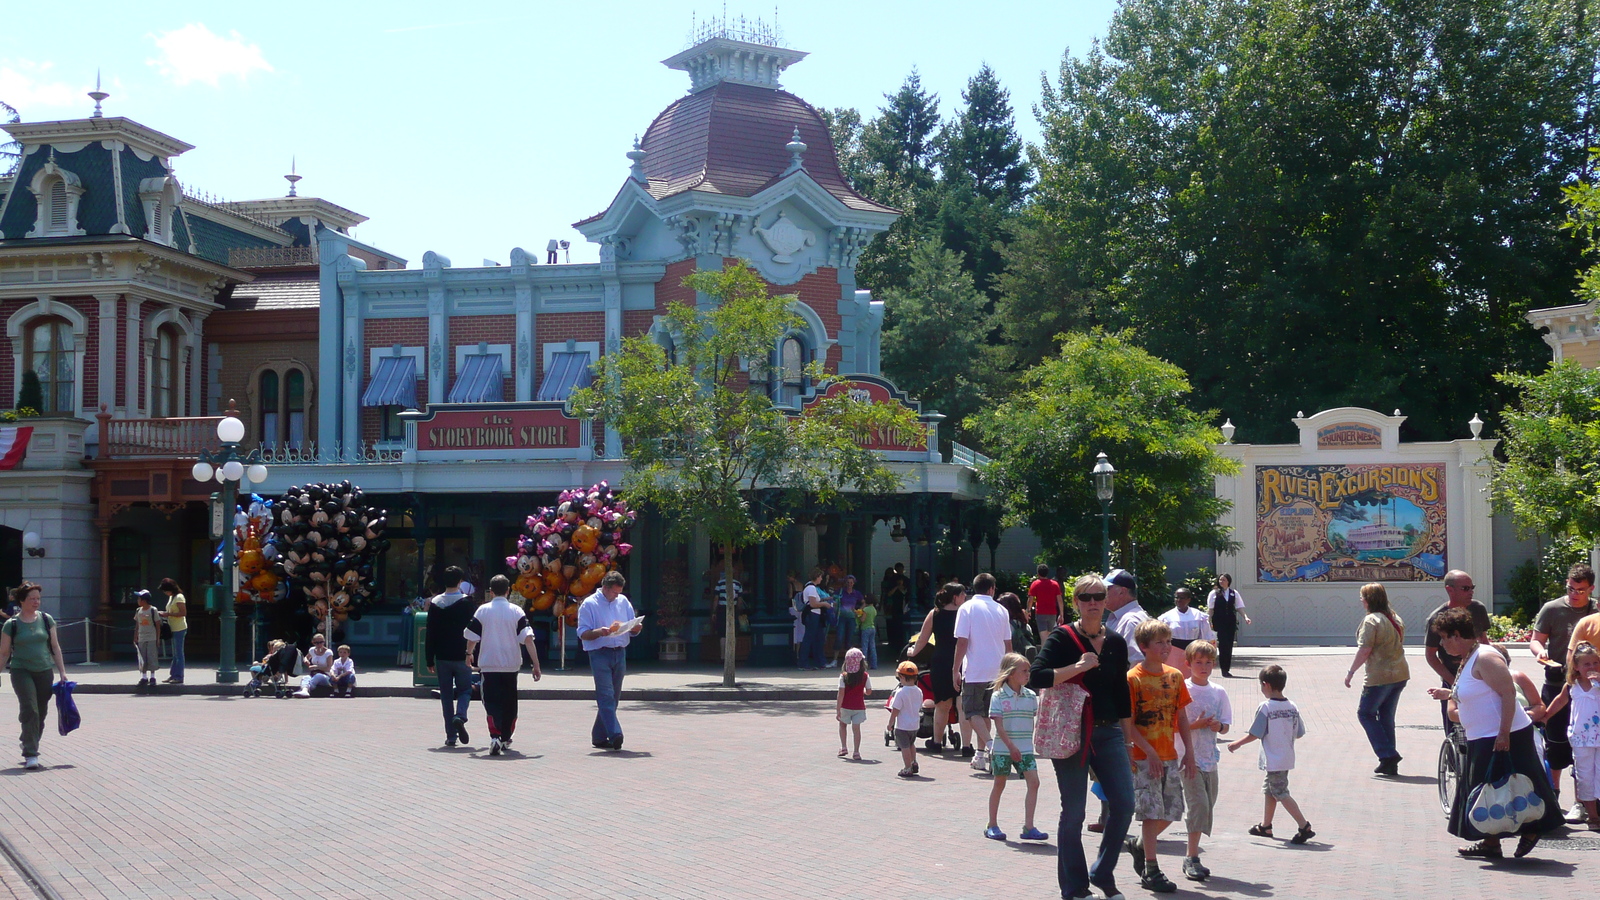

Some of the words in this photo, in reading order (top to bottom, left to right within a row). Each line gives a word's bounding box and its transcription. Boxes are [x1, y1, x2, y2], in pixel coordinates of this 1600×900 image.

[483, 414, 513, 425] the
[429, 427, 514, 447] STORYBOOK
[520, 426, 568, 446] STORE
[1322, 430, 1356, 442] THUNDER
[1258, 469, 1321, 514] RIVER
[1319, 467, 1438, 509] EXCURSIONS
[1349, 567, 1376, 578] MARK
[1002, 700, 1012, 712] 3
